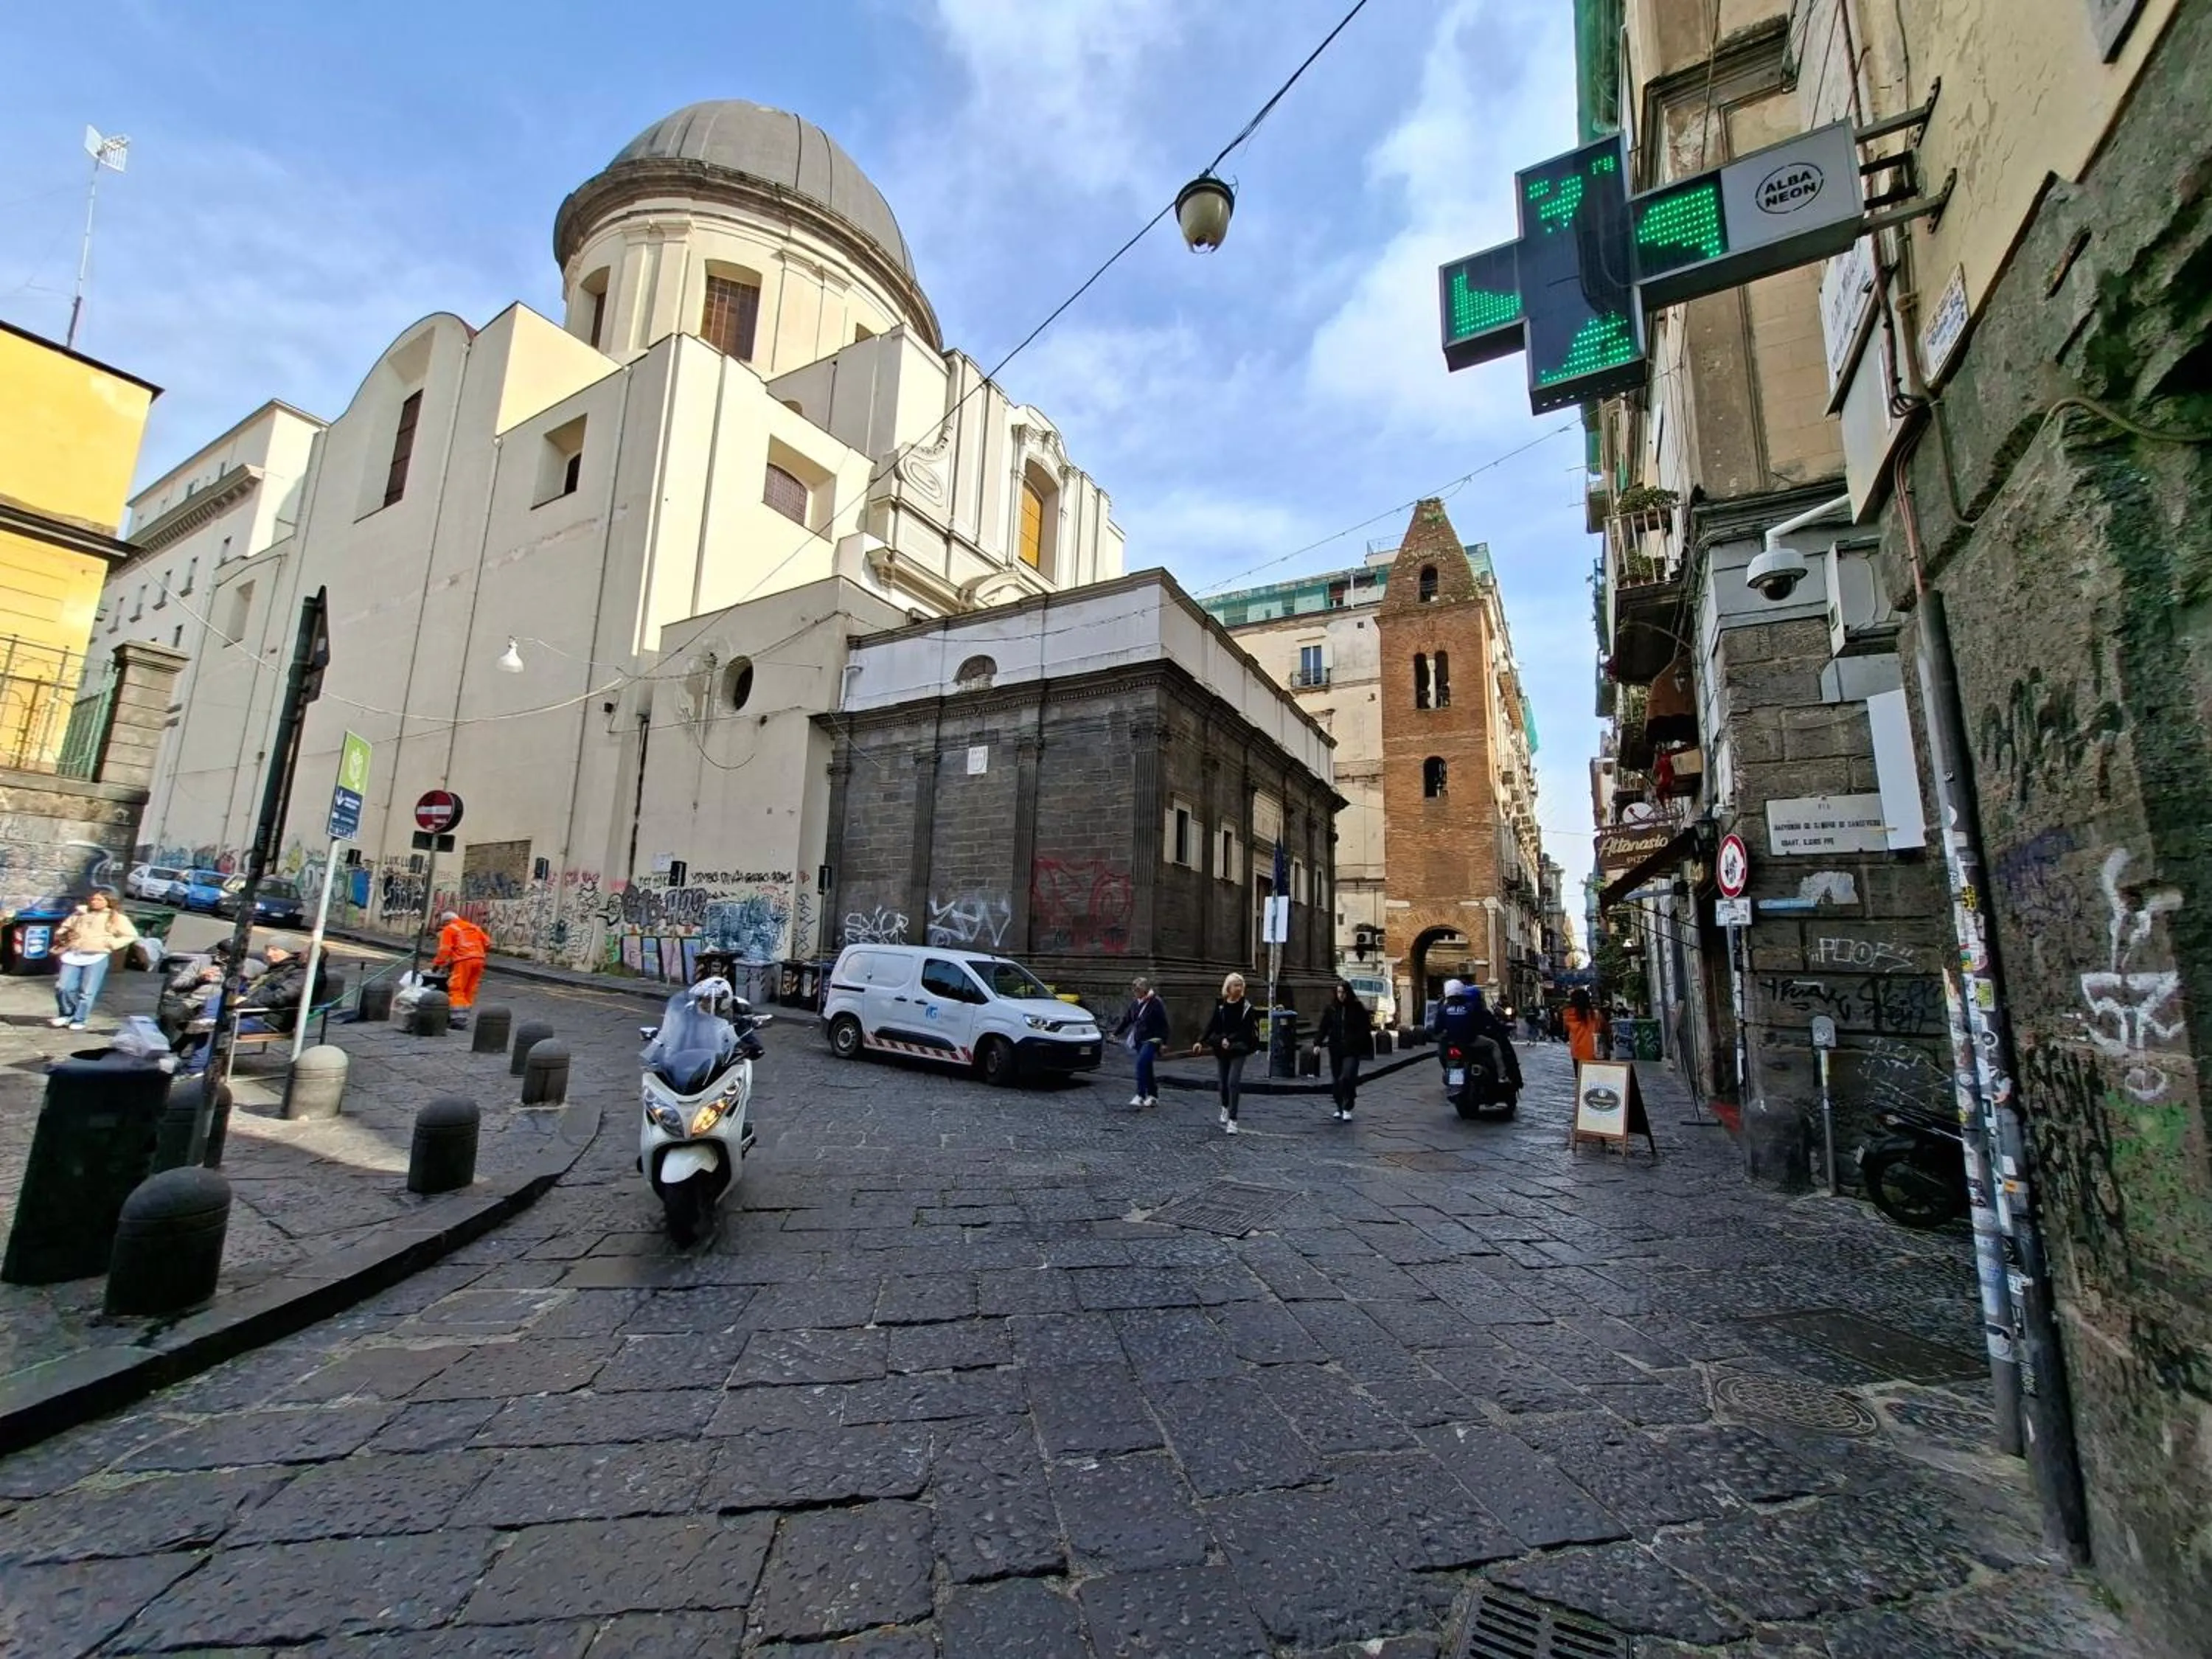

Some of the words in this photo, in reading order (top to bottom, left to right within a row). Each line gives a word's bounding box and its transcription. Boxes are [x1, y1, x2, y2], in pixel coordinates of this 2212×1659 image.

[1764, 170, 1812, 195] ALBA
[1765, 182, 1816, 207] NEON
[1599, 834, 1669, 858] Attanasio
